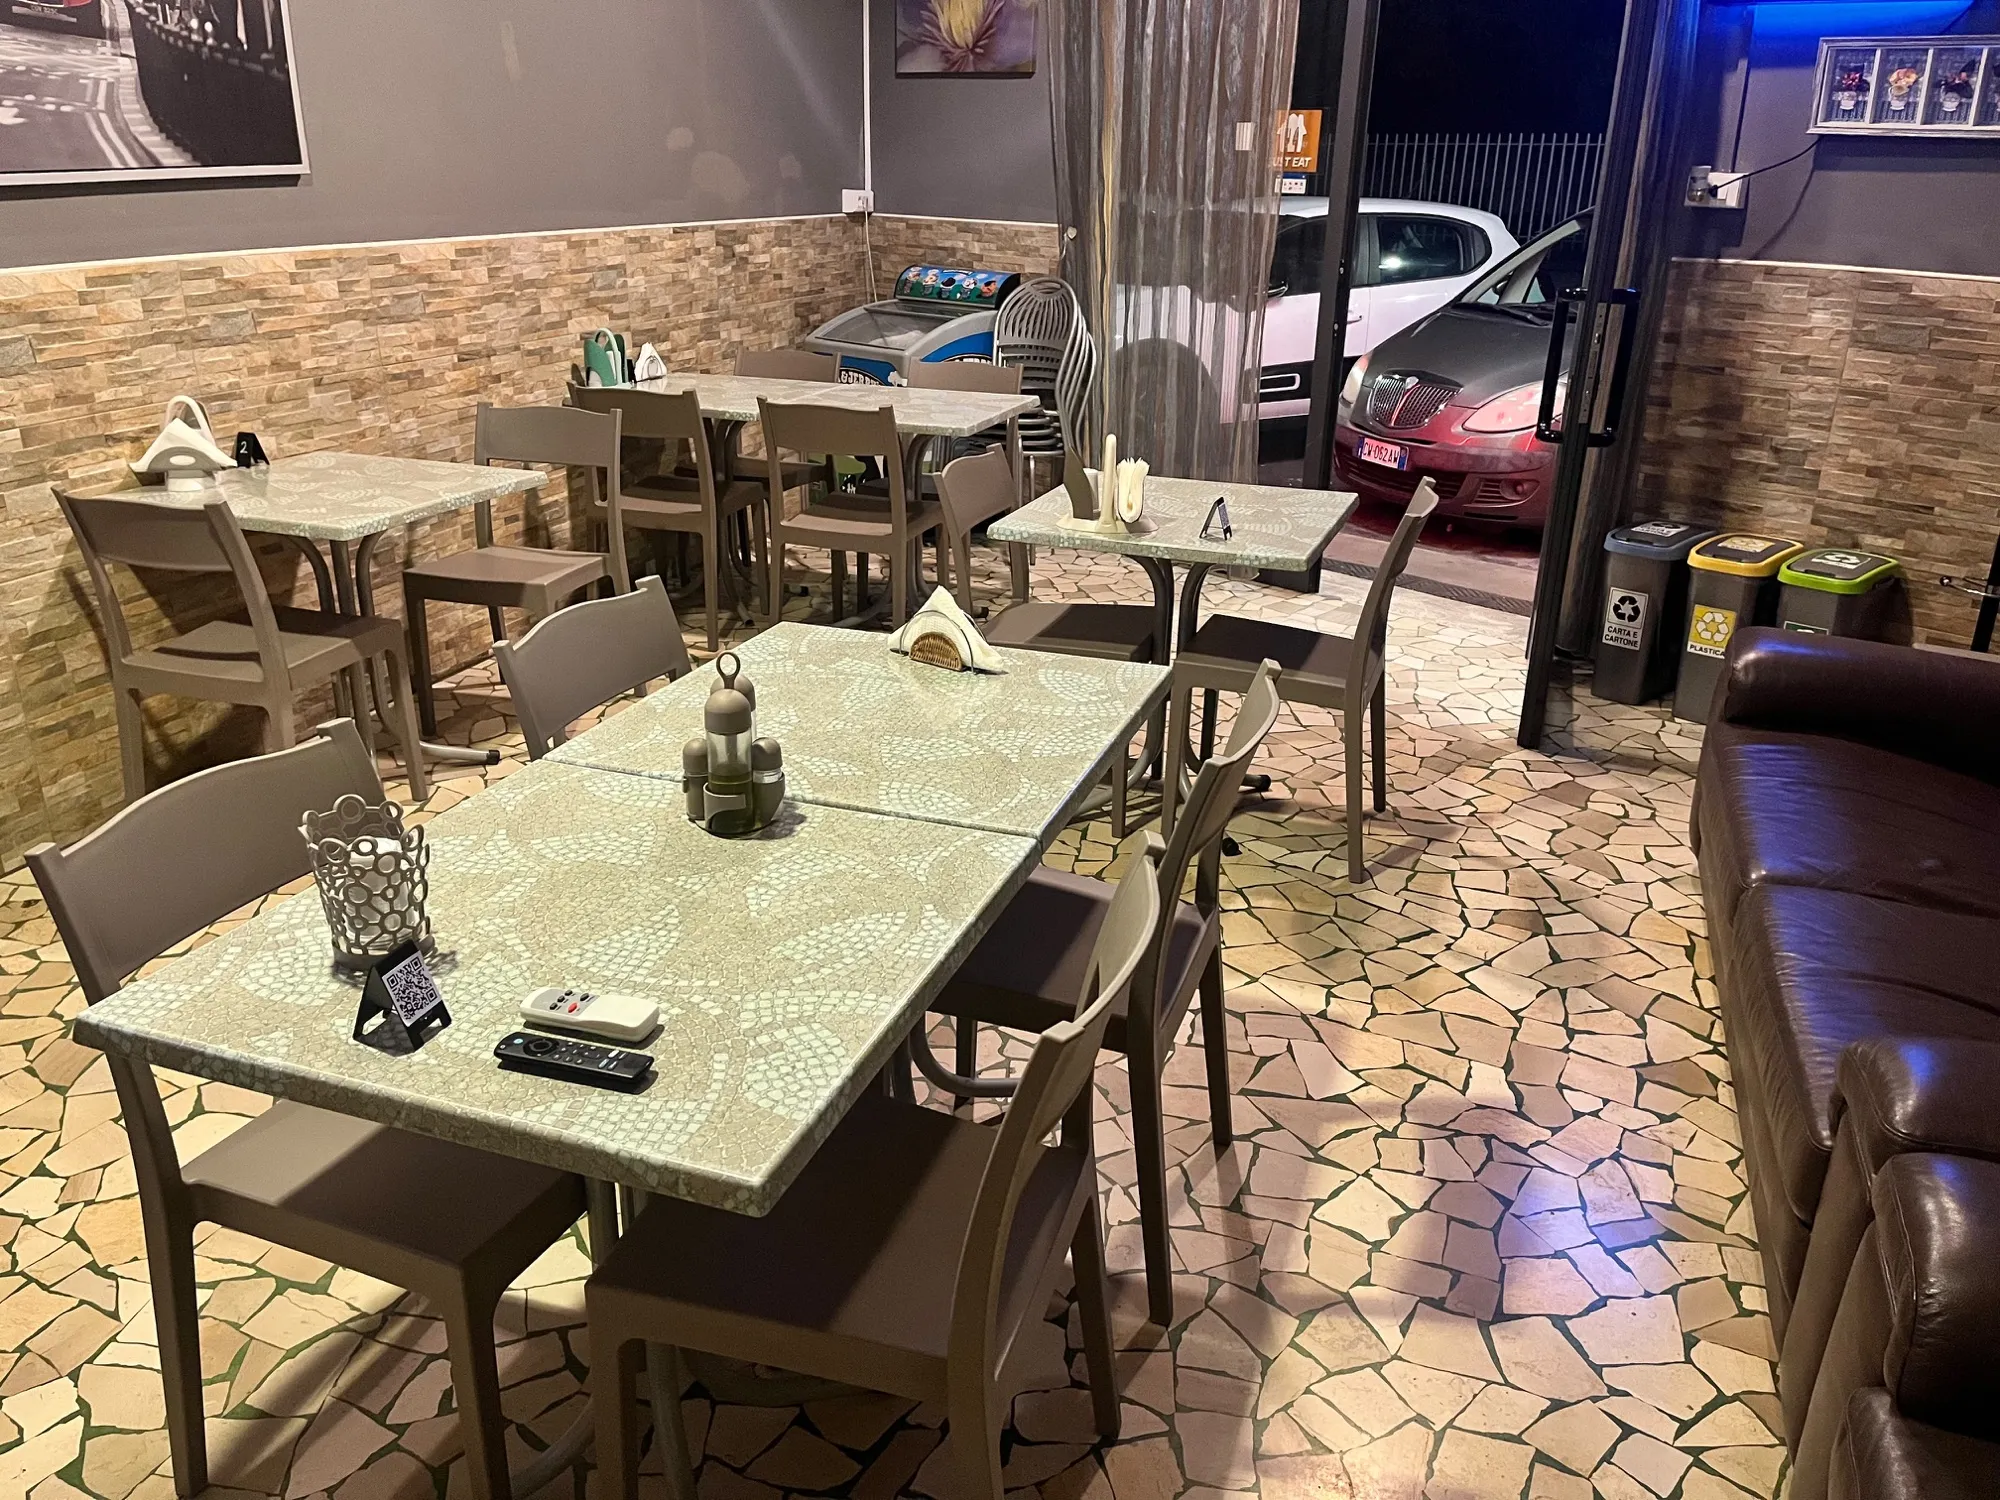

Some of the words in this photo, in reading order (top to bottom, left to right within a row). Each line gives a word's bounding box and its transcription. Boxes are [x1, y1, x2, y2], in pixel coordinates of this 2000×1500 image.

[1292, 156, 1312, 168] EAT
[240, 441, 248, 454] 2
[1608, 626, 1631, 637] CARTA
[1633, 631, 1638, 639] E
[1604, 634, 1639, 648] CARTONE
[1689, 644, 1725, 657] PLASTICA
